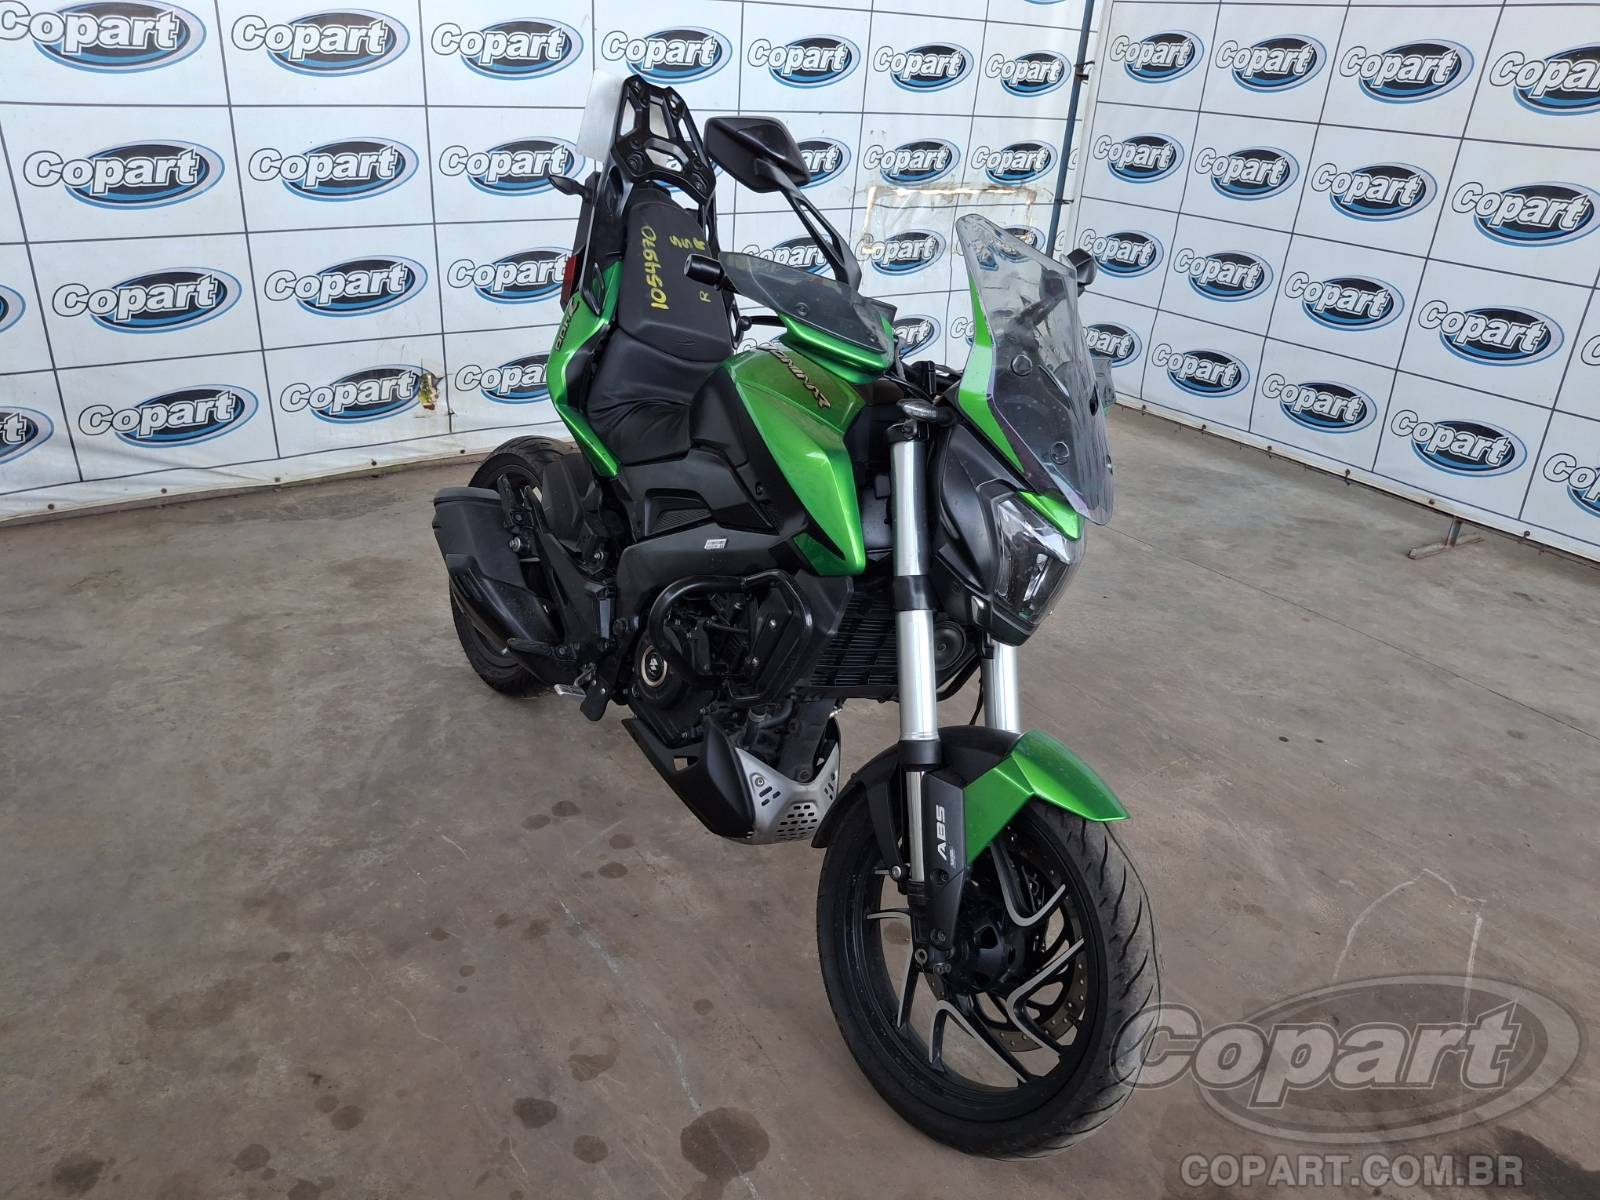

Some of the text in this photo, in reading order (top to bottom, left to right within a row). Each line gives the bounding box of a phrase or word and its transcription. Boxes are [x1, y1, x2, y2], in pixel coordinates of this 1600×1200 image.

[0, 0, 181, 55] Copart
[231, 15, 390, 61] Copart
[431, 23, 566, 65] Copart
[601, 31, 717, 69] Copart
[748, 39, 848, 76] Copart
[873, 46, 963, 80] Copart
[985, 53, 1063, 85] Copart
[1110, 35, 1193, 71] Copart
[1215, 40, 1314, 79] Copart
[1339, 46, 1459, 88] Copart
[1489, 51, 1600, 98] Copa
[23, 147, 201, 195] Copart
[248, 145, 399, 188] Copart
[439, 145, 569, 183] Copart
[801, 144, 839, 172] art
[863, 144, 952, 172] Copart
[971, 145, 1053, 174] Copart
[1093, 135, 1176, 170] Copart
[1195, 147, 1288, 186] Copart
[1311, 163, 1422, 206] Copart
[1452, 181, 1590, 230] Copart
[855, 233, 936, 267] Copart
[1079, 229, 1155, 266] Copart
[1174, 248, 1261, 289] Copart
[264, 262, 408, 306] Copart
[448, 252, 568, 294] Copart
[52, 274, 220, 321] Copart
[1285, 271, 1391, 319] Copart
[893, 320, 932, 345] art
[1082, 326, 1133, 358] part
[1418, 300, 1548, 353] Copart
[455, 365, 548, 396] Copa
[1152, 343, 1238, 387] Copart
[280, 370, 418, 415] Copart
[1262, 373, 1367, 422] Copart
[78, 390, 236, 438] Copart
[1391, 409, 1510, 466] Copart
[935, 804, 947, 861] ABS
